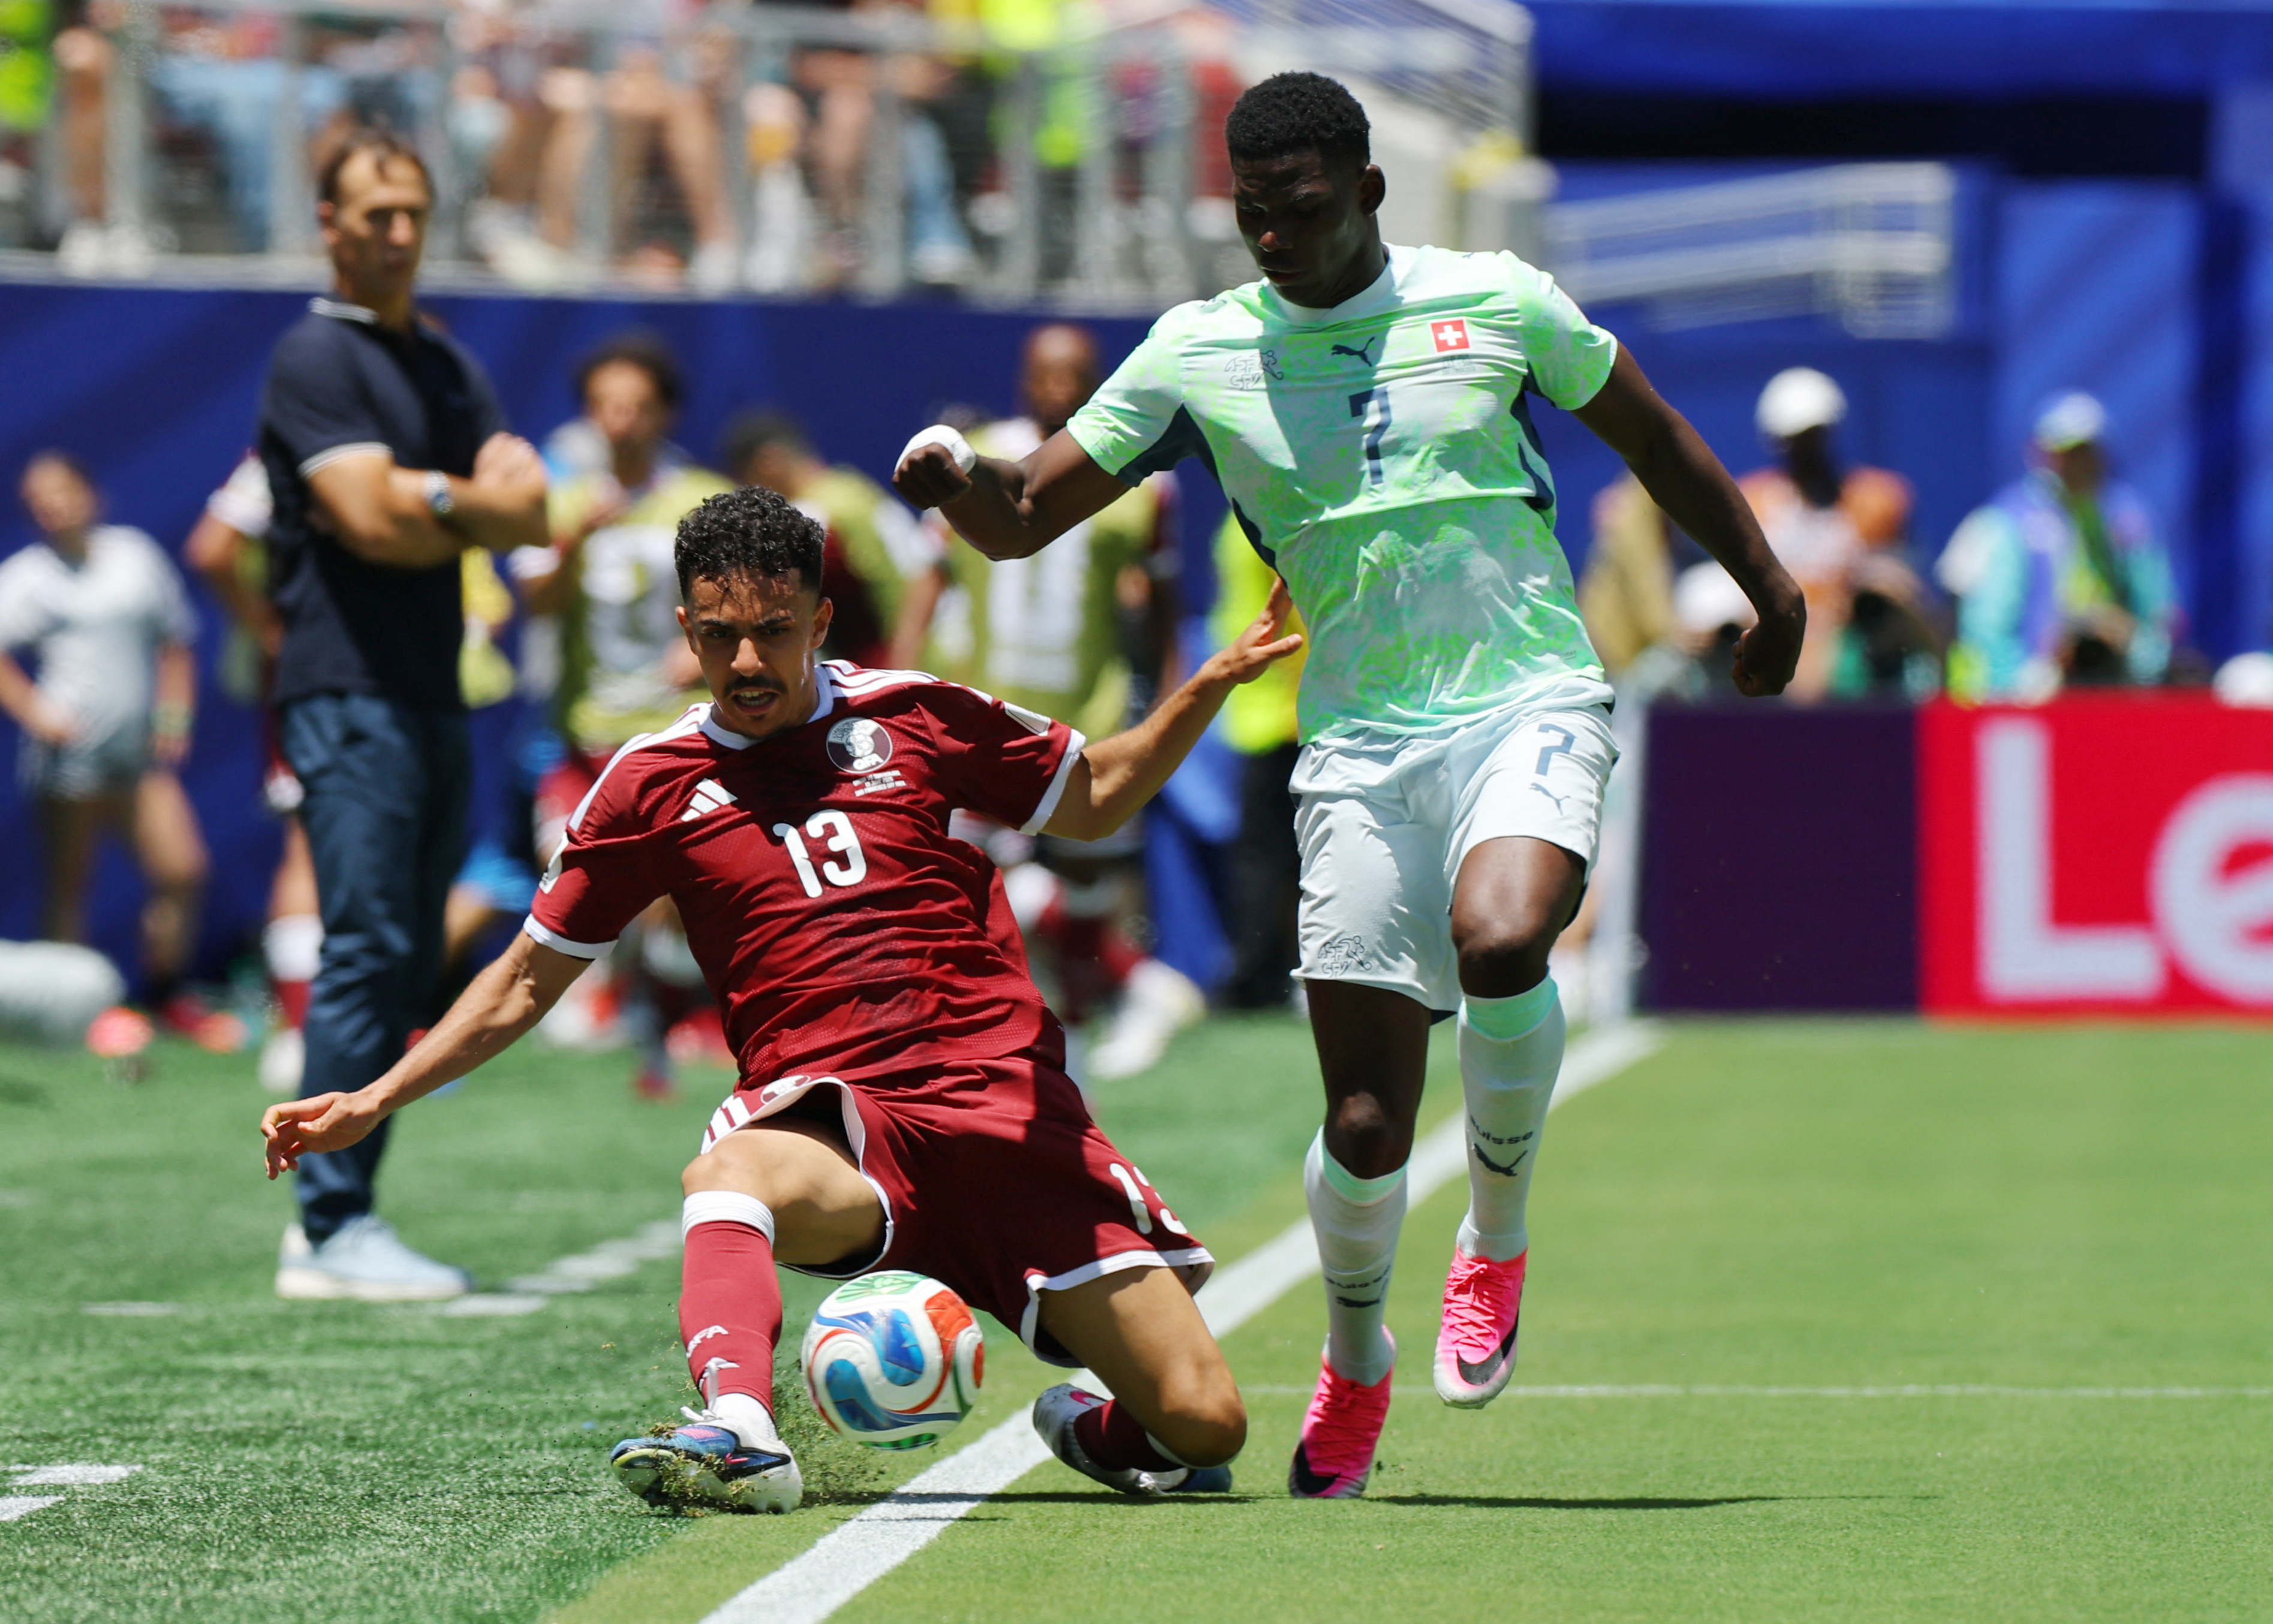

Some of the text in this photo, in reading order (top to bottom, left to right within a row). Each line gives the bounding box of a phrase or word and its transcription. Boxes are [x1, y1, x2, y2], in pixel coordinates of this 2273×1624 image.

[1348, 386, 1392, 486] 7
[853, 753, 884, 770] QFA
[1535, 723, 1577, 776] 7
[772, 809, 867, 898] 13
[1975, 716, 2273, 1003] Le
